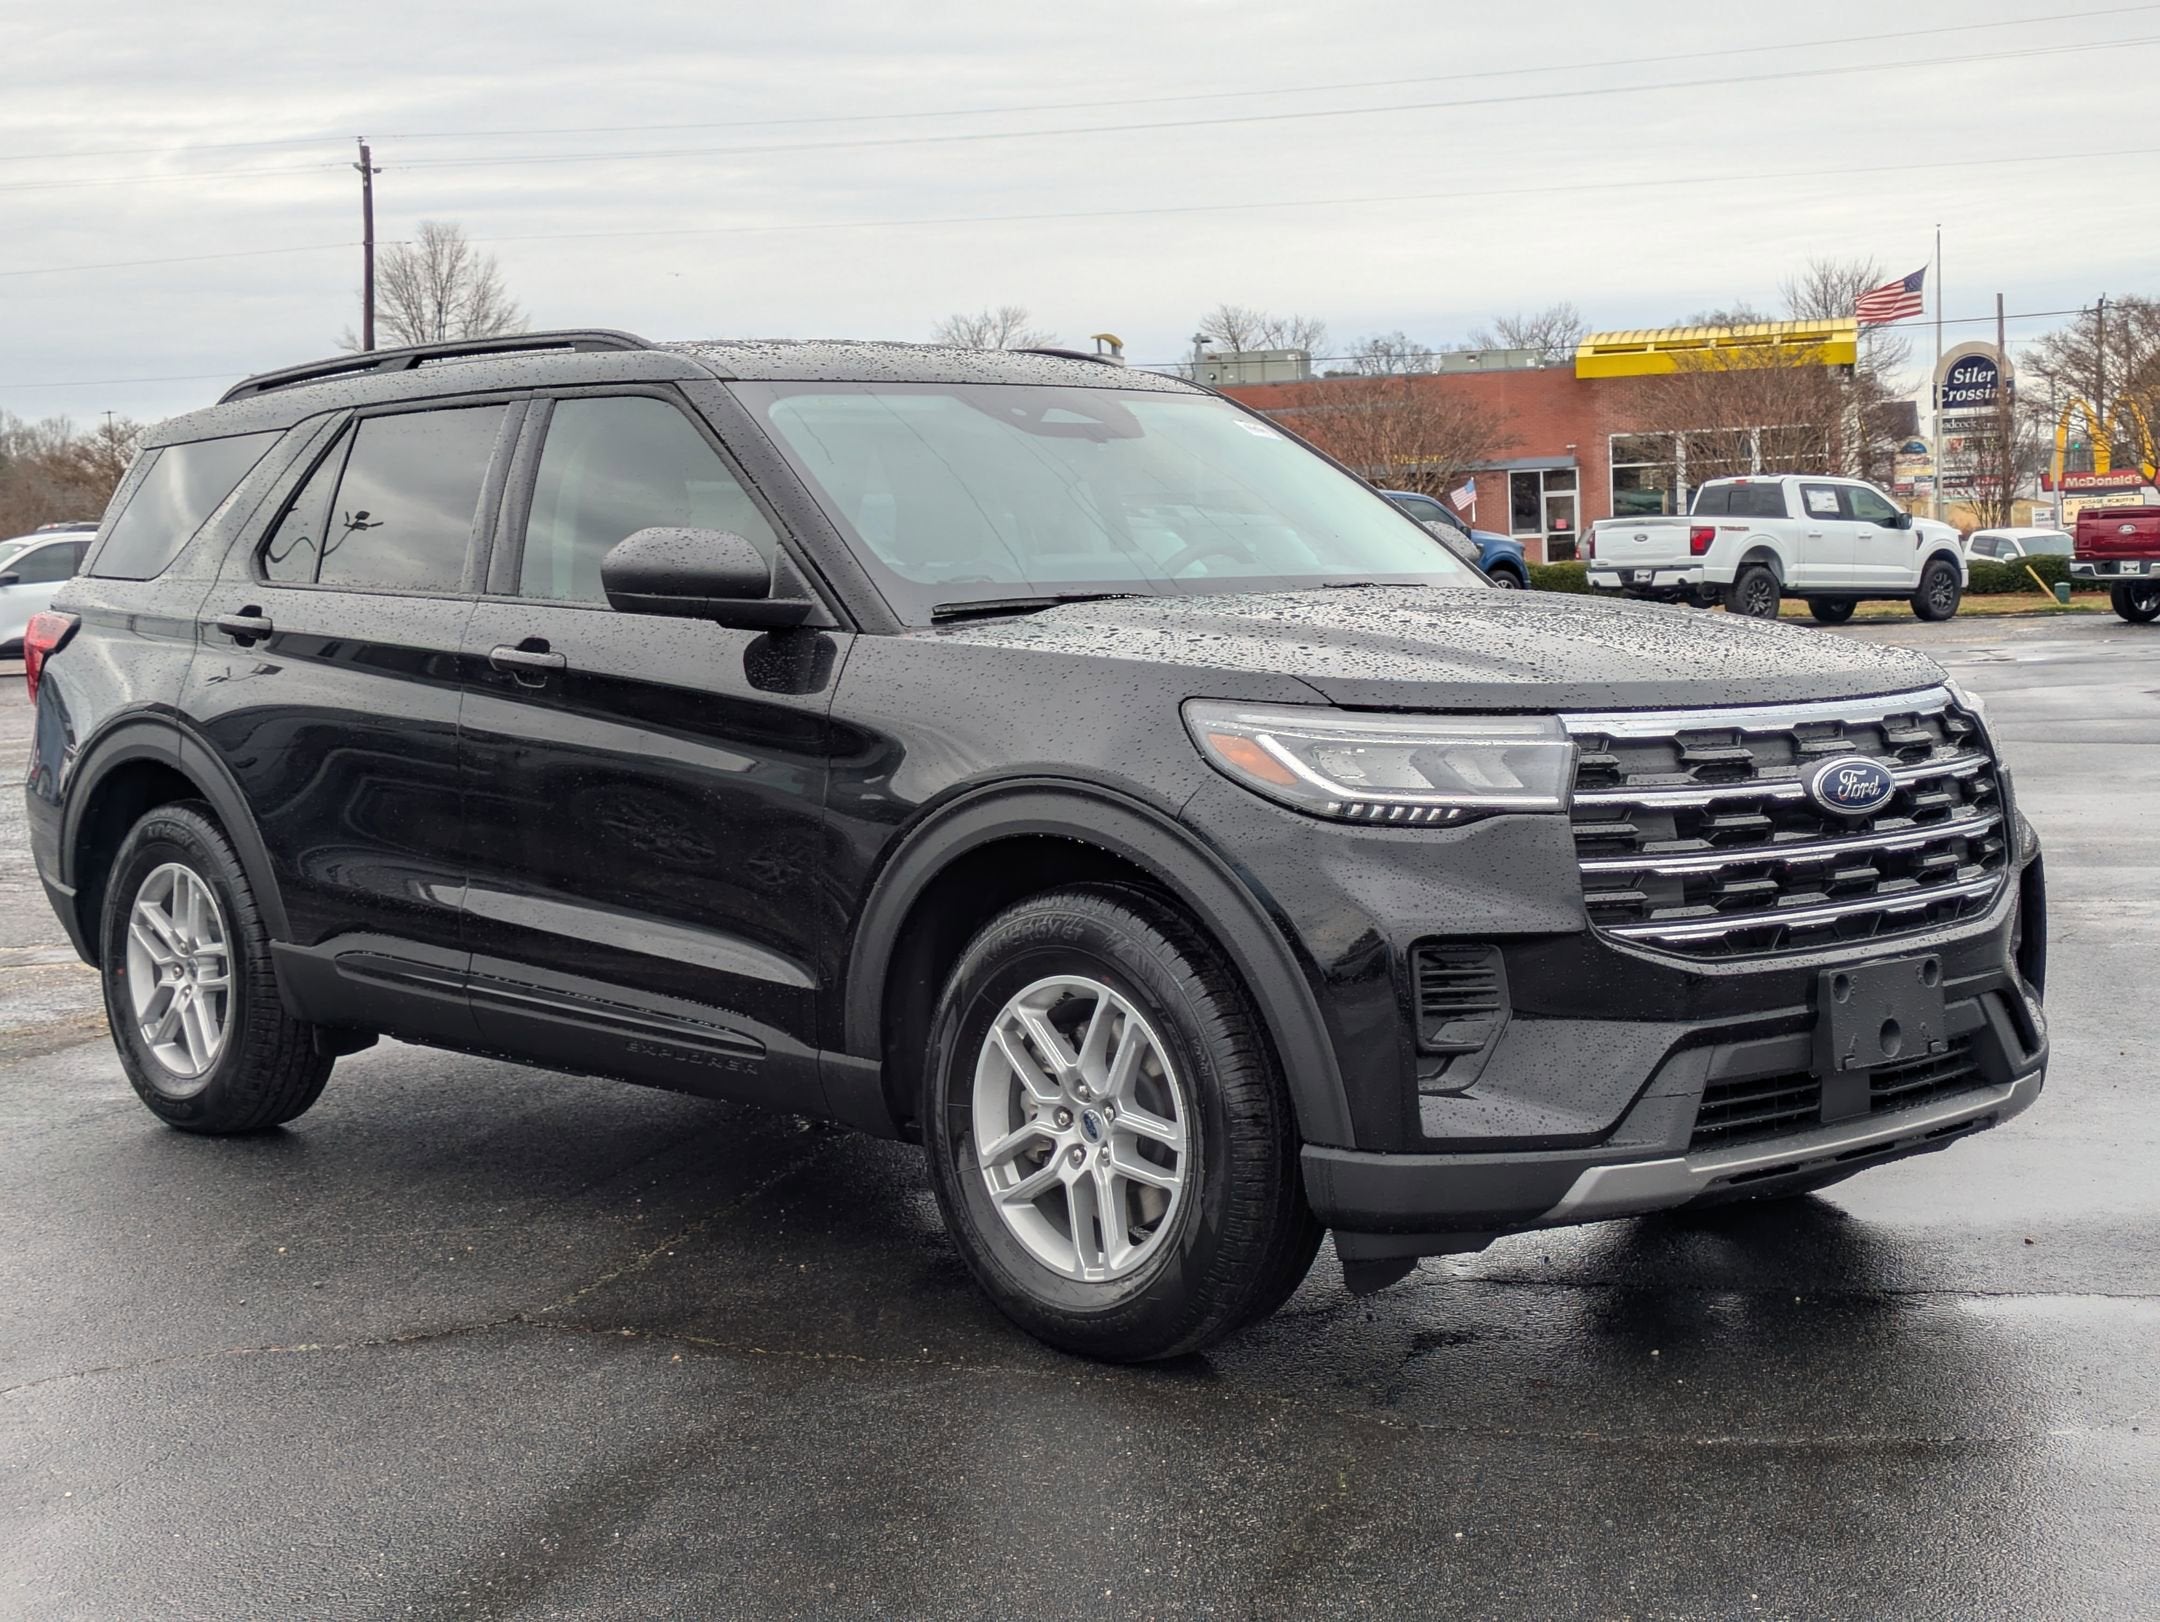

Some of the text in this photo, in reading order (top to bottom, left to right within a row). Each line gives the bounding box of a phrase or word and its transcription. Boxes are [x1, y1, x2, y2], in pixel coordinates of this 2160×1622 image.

[1953, 366, 1995, 384] Siler
[2065, 475, 2142, 487] McDonald's
[1838, 769, 1881, 801] Ford
[626, 1040, 758, 1076] EXPLORER
